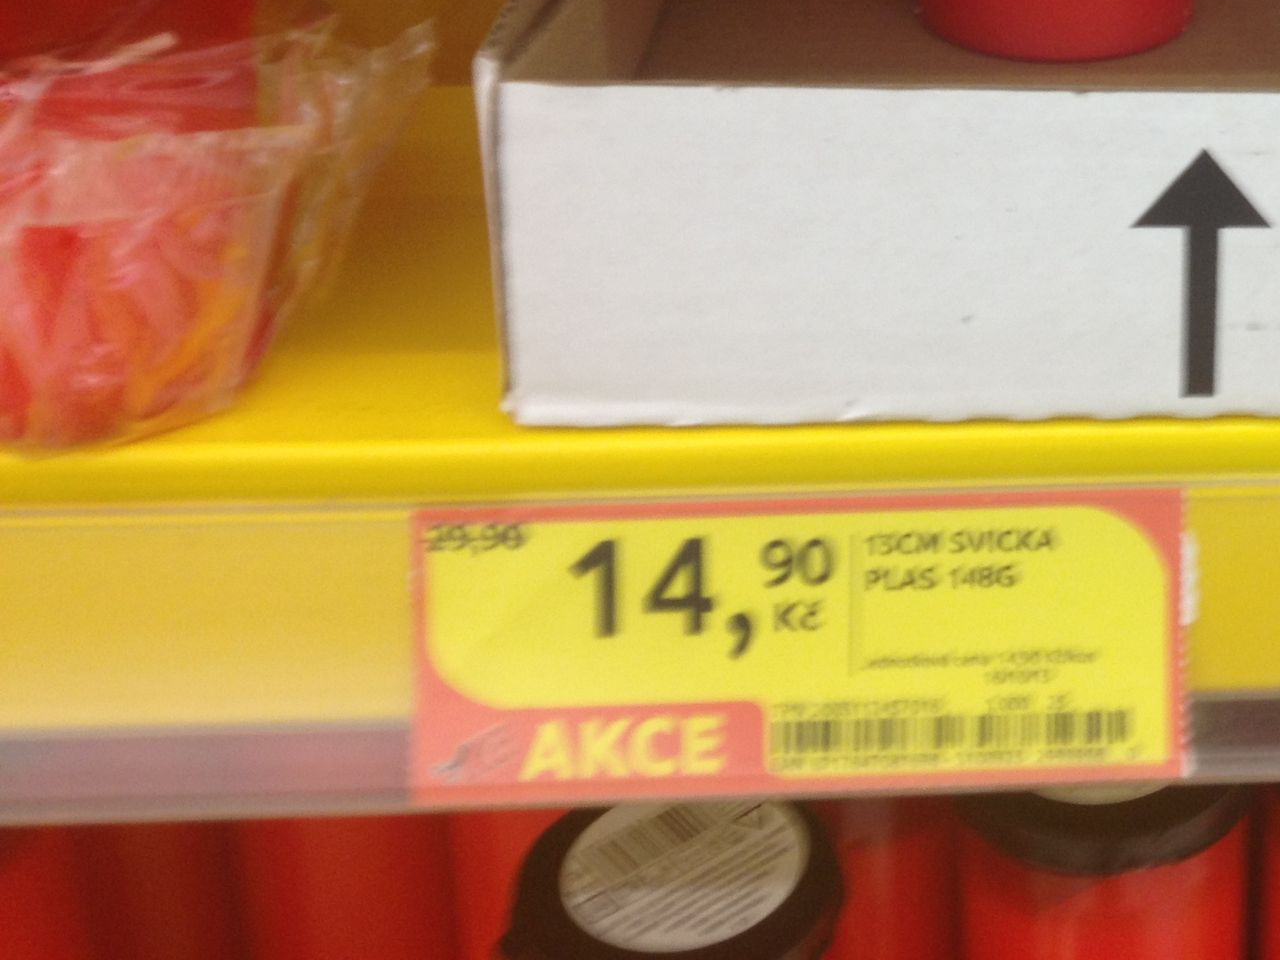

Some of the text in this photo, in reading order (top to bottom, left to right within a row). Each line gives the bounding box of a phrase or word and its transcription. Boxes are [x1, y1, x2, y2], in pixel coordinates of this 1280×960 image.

[760, 536, 836, 588] 90
[864, 564, 940, 592] PLAS
[517, 712, 730, 783] AKCE
